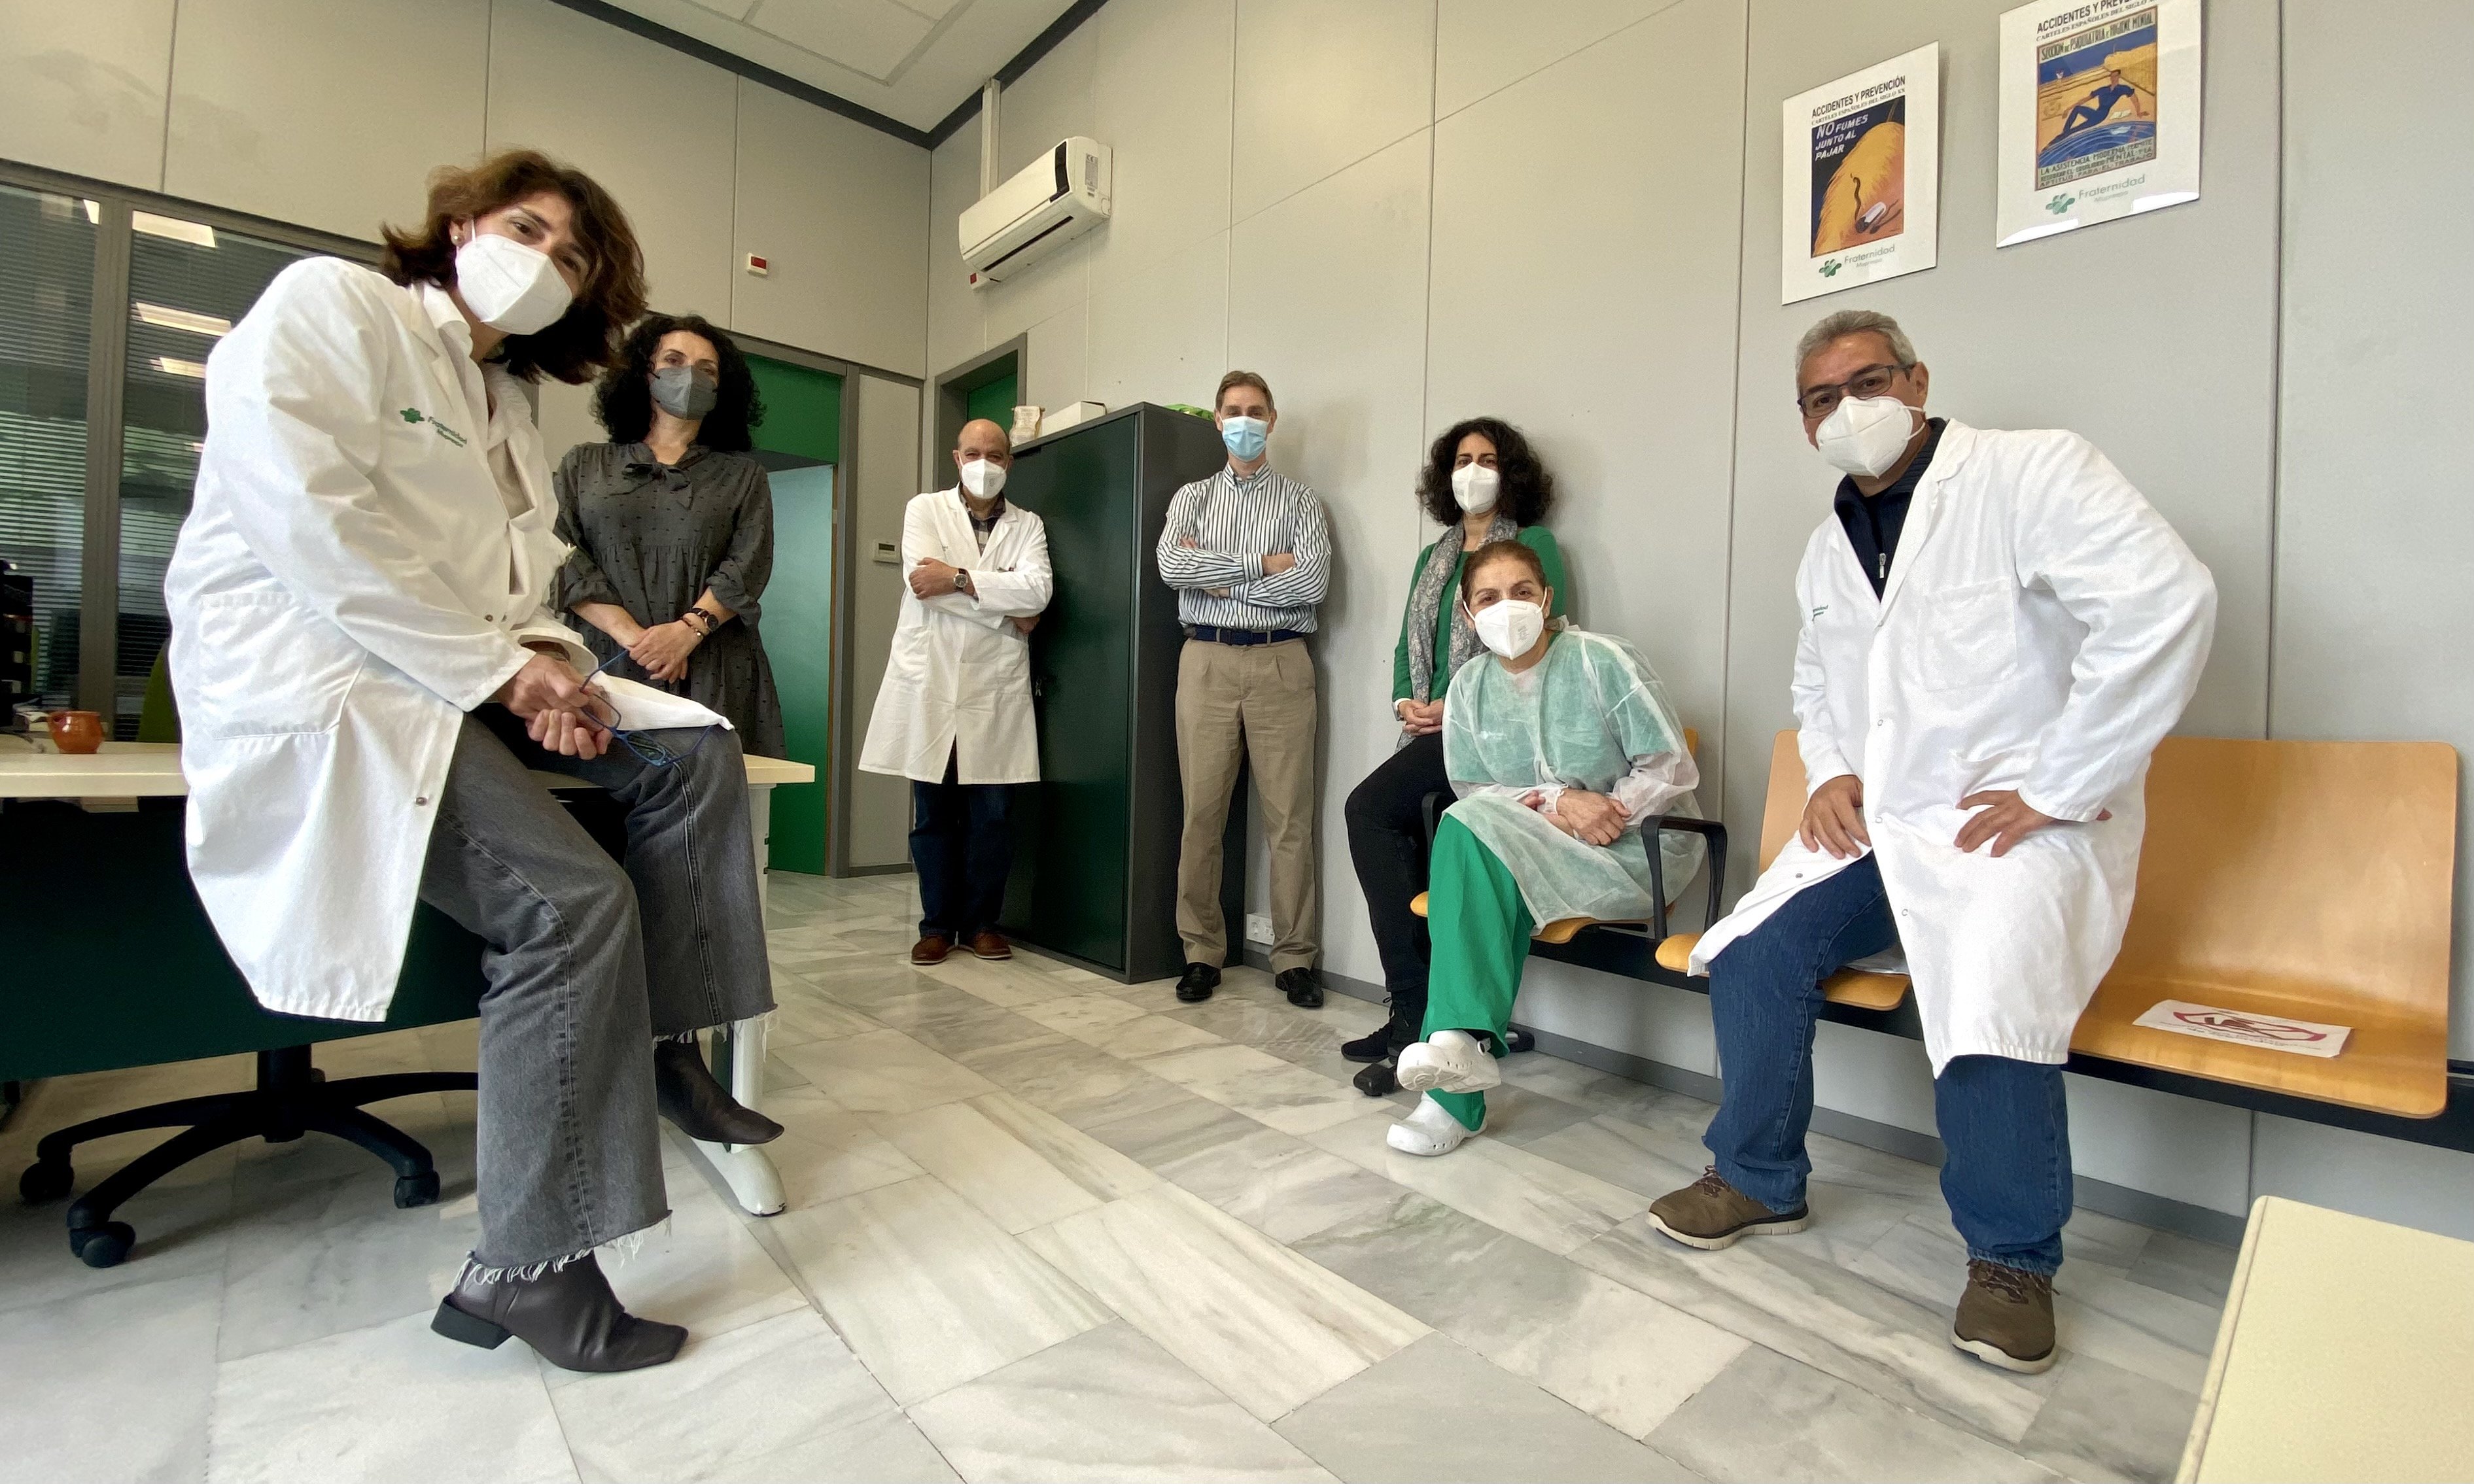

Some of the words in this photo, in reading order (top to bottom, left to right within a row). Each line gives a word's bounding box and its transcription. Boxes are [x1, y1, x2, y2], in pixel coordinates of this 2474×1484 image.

[2036, 25, 2070, 42] CARTELES
[2072, 11, 2110, 29] ESPAÑOLES
[2037, 5, 2091, 34] ACCIDENTES
[2093, 3, 2100, 14] Y
[1812, 95, 1853, 118] ACCIDENTES
[1855, 92, 1860, 103] Y
[1860, 75, 1906, 101] PREVENCIÓN
[1817, 122, 1835, 139] NO
[1836, 114, 1869, 133] FUMES
[1815, 133, 1844, 150] JUNTO
[1845, 129, 1856, 141] AL
[1815, 144, 1845, 162] PAJAR
[2106, 151, 2135, 164] MENTAL
[2079, 174, 2146, 199] Fraternidad
[1844, 243, 1895, 265] Fraternidad
